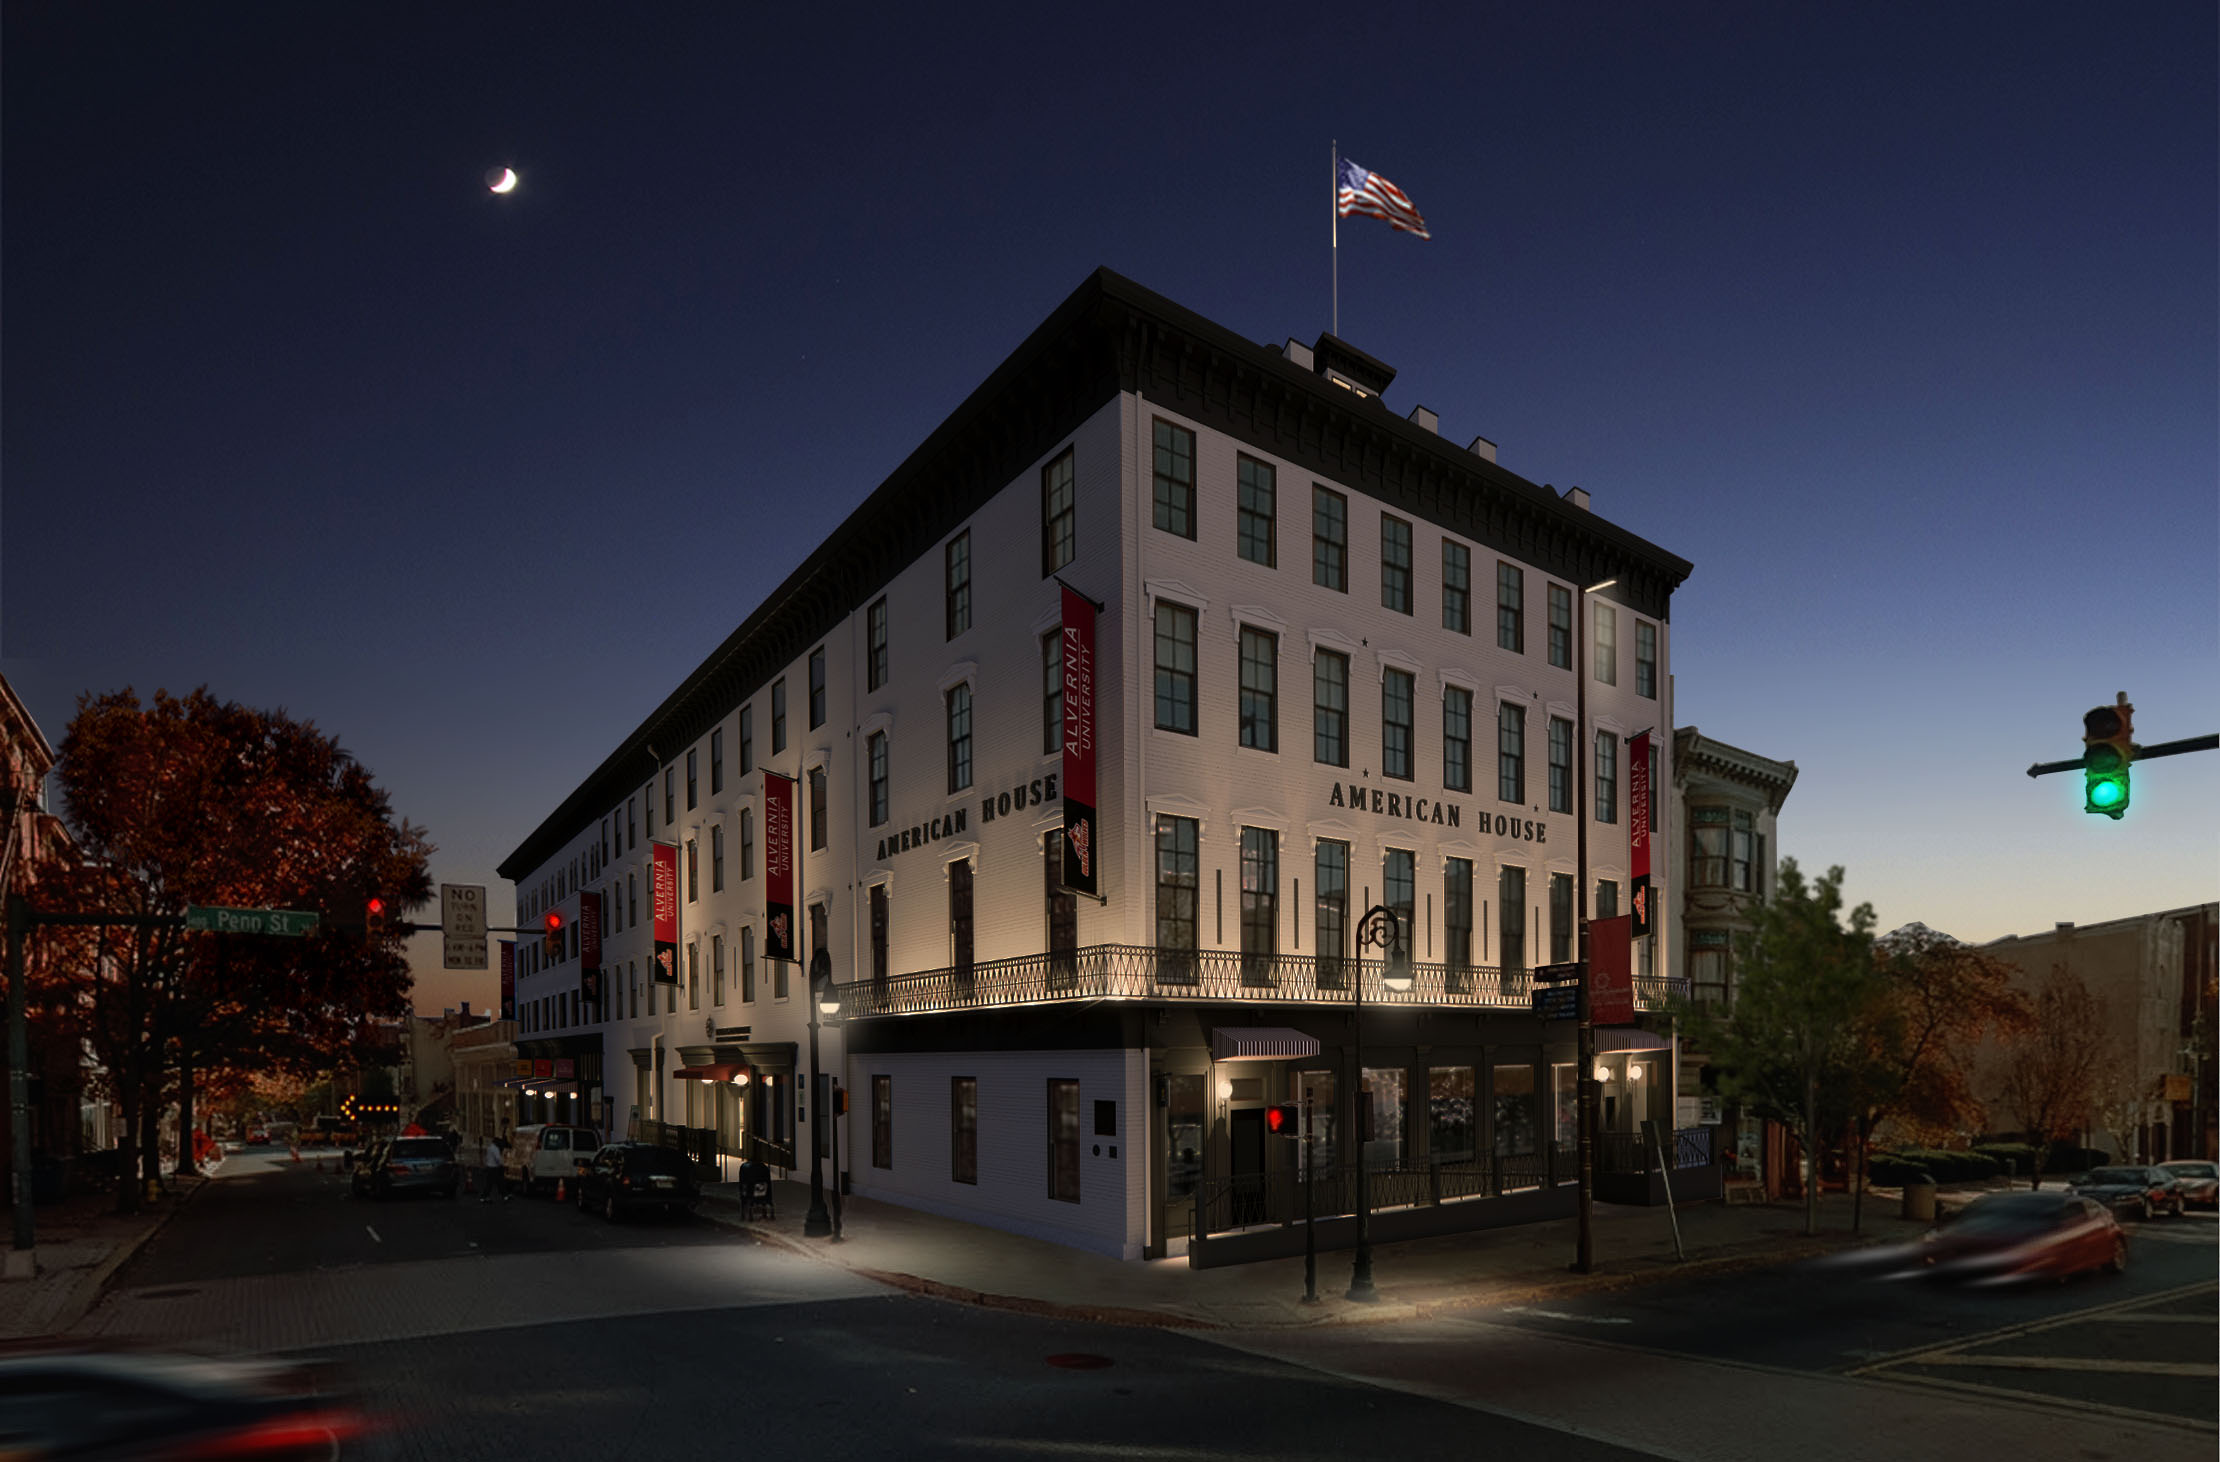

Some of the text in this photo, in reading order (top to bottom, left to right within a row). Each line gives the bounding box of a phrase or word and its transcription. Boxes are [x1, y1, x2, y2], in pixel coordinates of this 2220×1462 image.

[1064, 627, 1079, 758] ALVERNIA
[1081, 644, 1091, 750] UNIVERSITY
[876, 773, 1057, 861] AMERICAN HOUSE
[1329, 782, 1547, 844] AMERICAN HOUSE
[1631, 760, 1640, 848] ALVERNIA
[767, 796, 778, 877] ALVERNIA
[781, 806, 790, 871] UNIVERSITY
[217, 910, 264, 934] Penn
[270, 913, 289, 933] St
[451, 889, 476, 901] NO
[451, 902, 477, 912] TURN
[456, 913, 472, 922] ON
[655, 860, 665, 922] ALVERNIA
[666, 867, 675, 918] UNIVERSITY
[455, 924, 473, 933] RED
